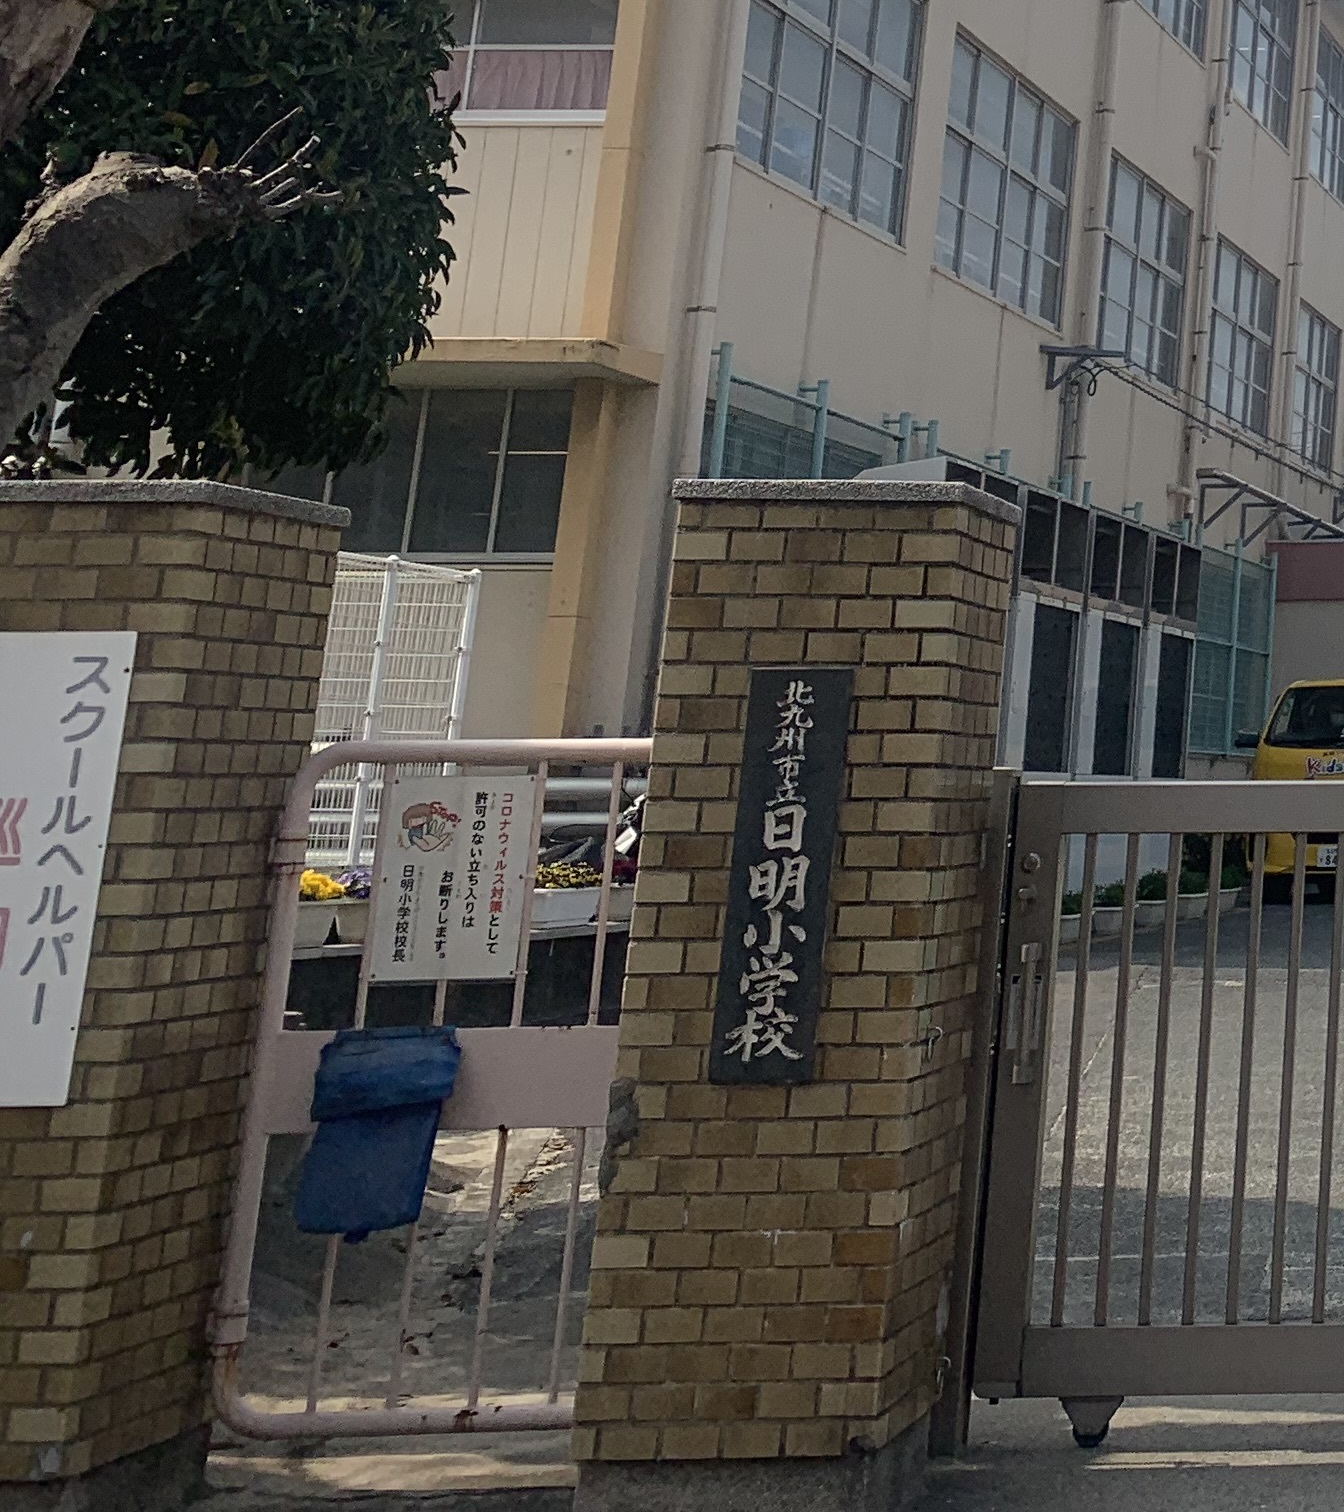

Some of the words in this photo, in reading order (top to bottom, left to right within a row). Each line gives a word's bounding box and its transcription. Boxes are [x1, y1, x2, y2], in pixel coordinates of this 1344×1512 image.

[20, 657, 110, 1025] スクールヘルパー
[462, 792, 488, 928] 許可のない立ち入りは
[392, 865, 415, 962] 日明小学校校長
